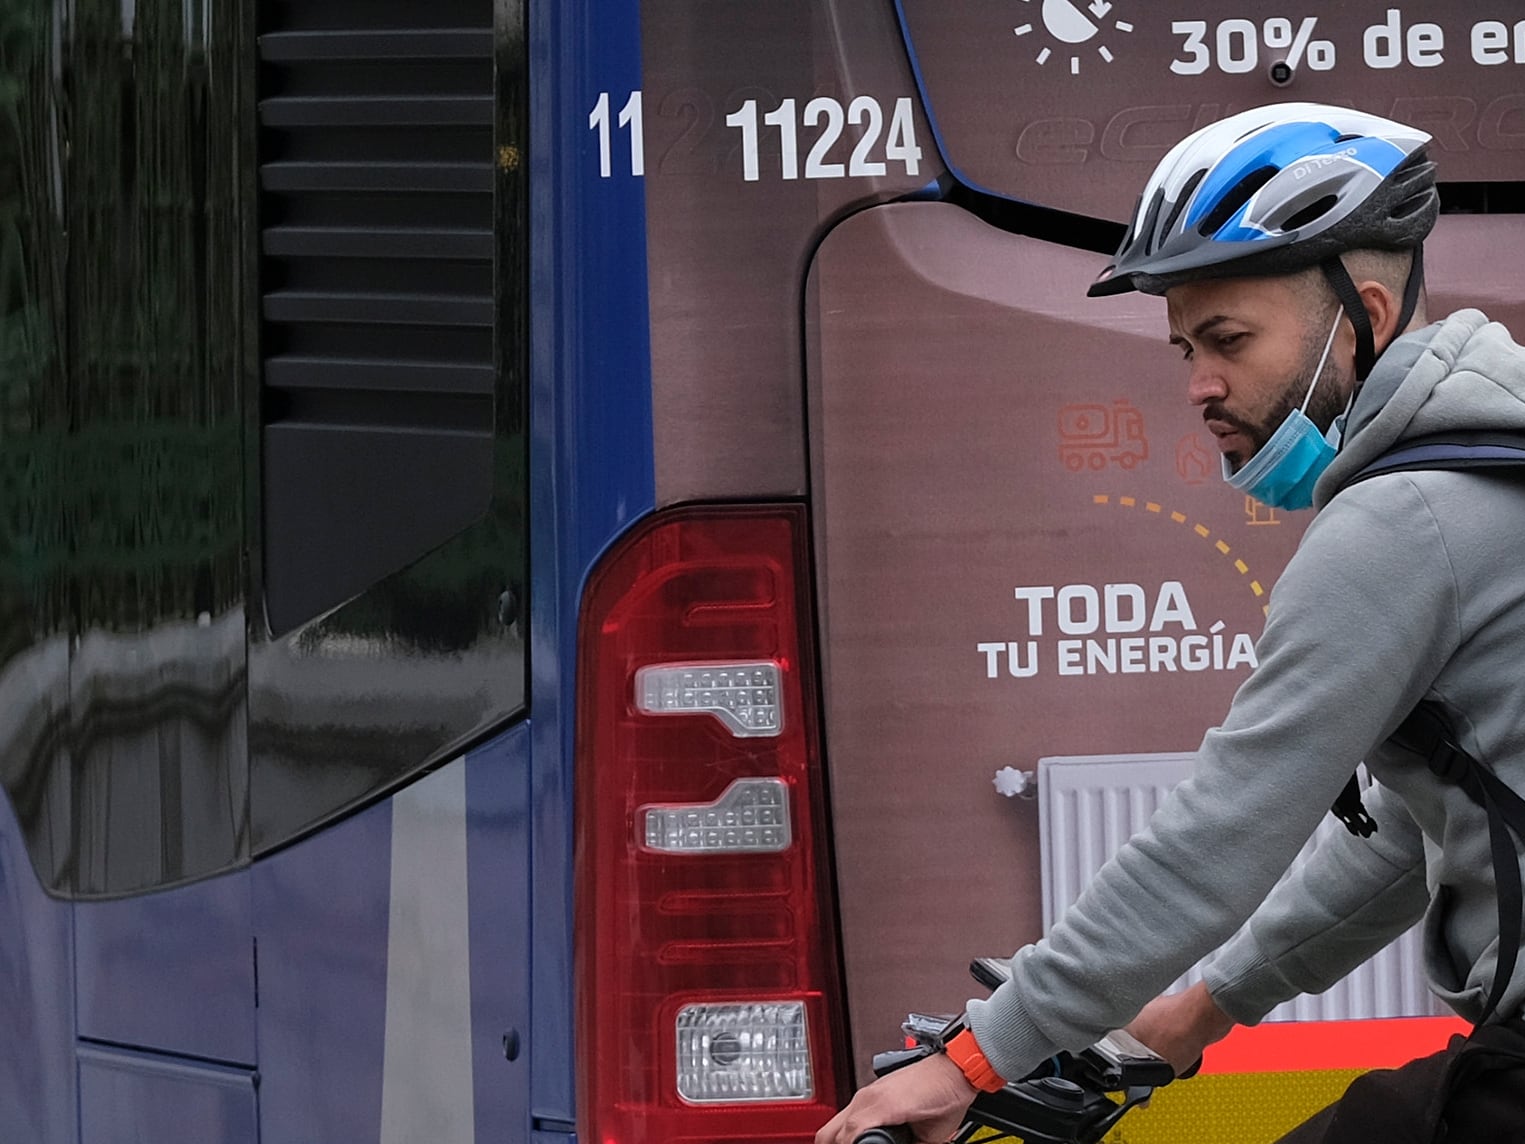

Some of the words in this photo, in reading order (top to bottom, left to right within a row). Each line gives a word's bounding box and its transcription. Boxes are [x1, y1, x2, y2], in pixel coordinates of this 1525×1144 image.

[1170, 17, 1336, 75] 30%
[1363, 9, 1444, 70] de
[726, 96, 922, 181] 11224
[1015, 581, 1196, 636] TODA
[977, 641, 1038, 678] TU
[1058, 620, 1259, 675] ENERGÍA
